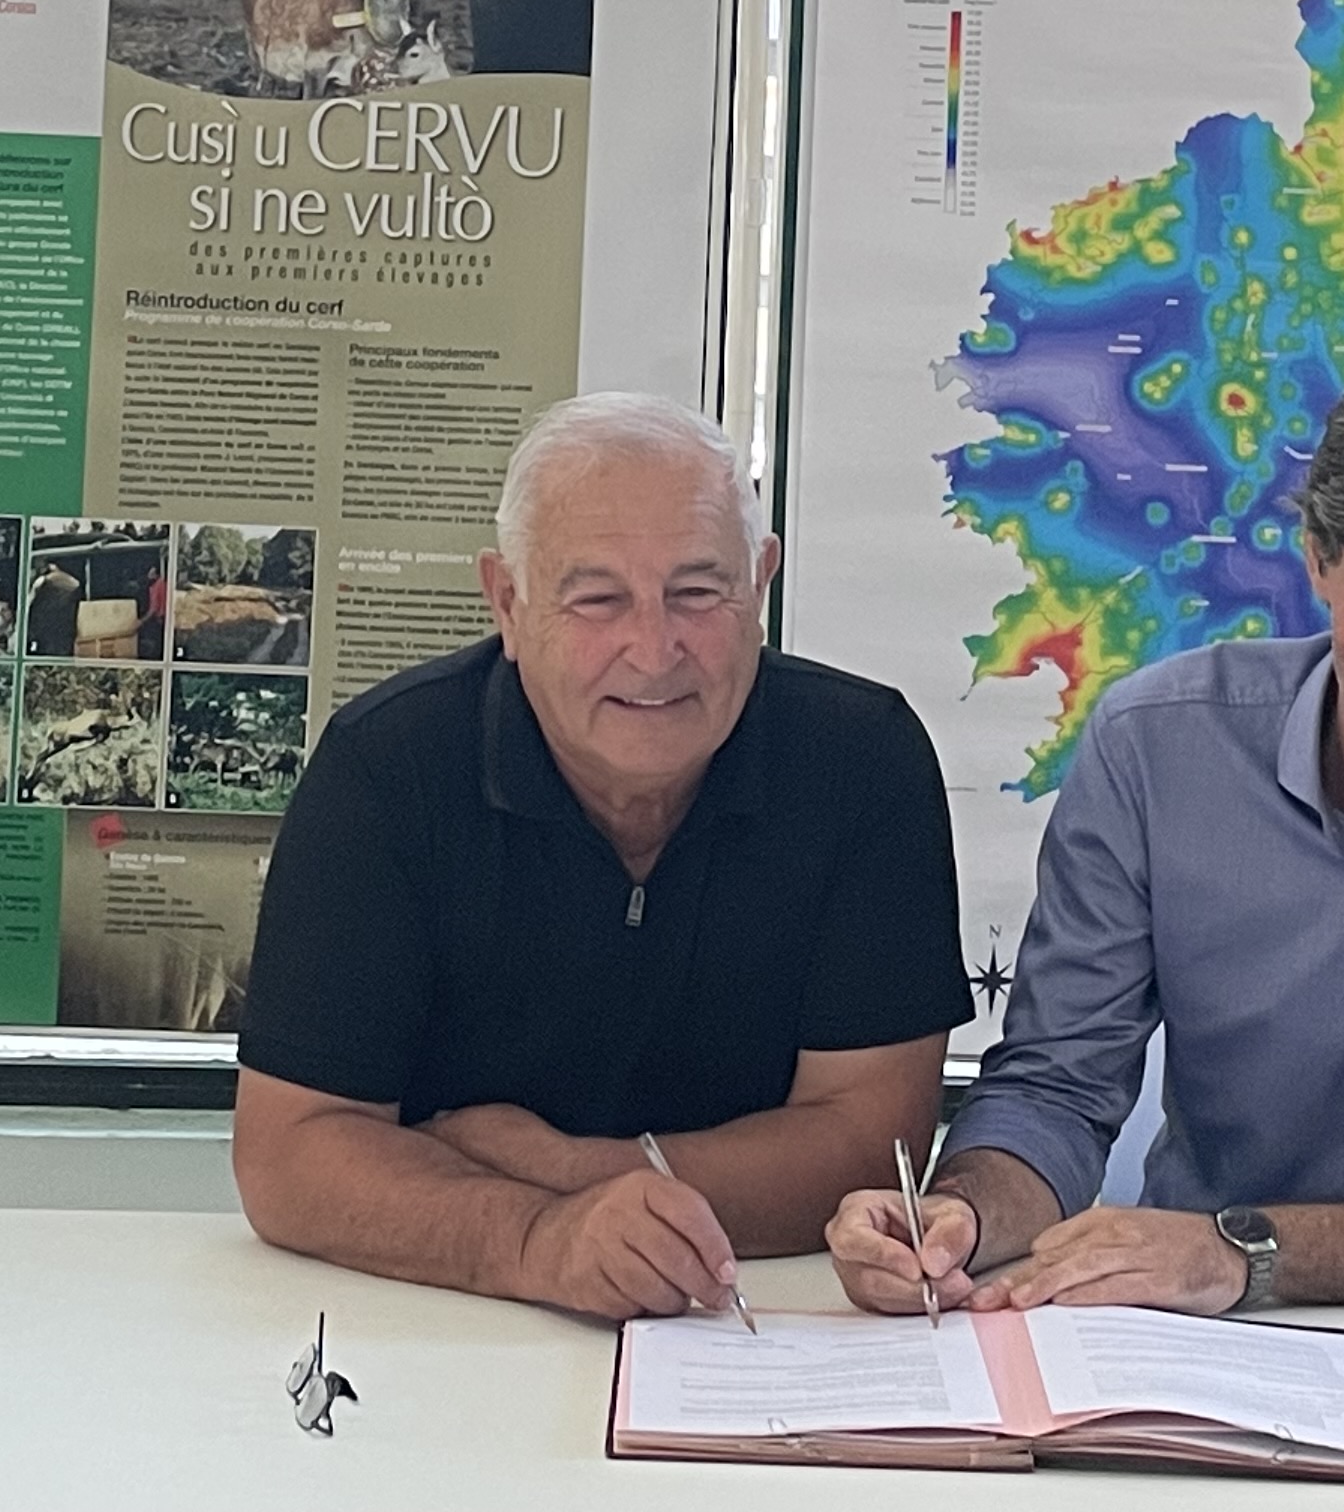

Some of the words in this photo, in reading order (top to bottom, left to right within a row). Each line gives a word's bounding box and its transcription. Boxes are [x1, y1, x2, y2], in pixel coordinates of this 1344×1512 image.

[122, 100, 239, 165] Cusì
[256, 124, 287, 167] u
[308, 97, 564, 179] CERVU
[189, 168, 232, 231] si
[254, 187, 326, 235] ne
[344, 172, 494, 241] vultò
[189, 242, 227, 257] des
[245, 245, 367, 263] premières
[384, 249, 491, 268] captures
[195, 262, 234, 277] aux
[251, 264, 359, 282] premiers
[377, 266, 484, 288] élevages
[126, 290, 269, 312] Réintroduction
[275, 296, 300, 314] du
[306, 299, 344, 316] cerf
[349, 343, 418, 361] Principaux
[422, 346, 500, 360] fondements
[349, 357, 365, 368] de
[369, 357, 402, 369] cette
[989, 924, 1002, 938] N
